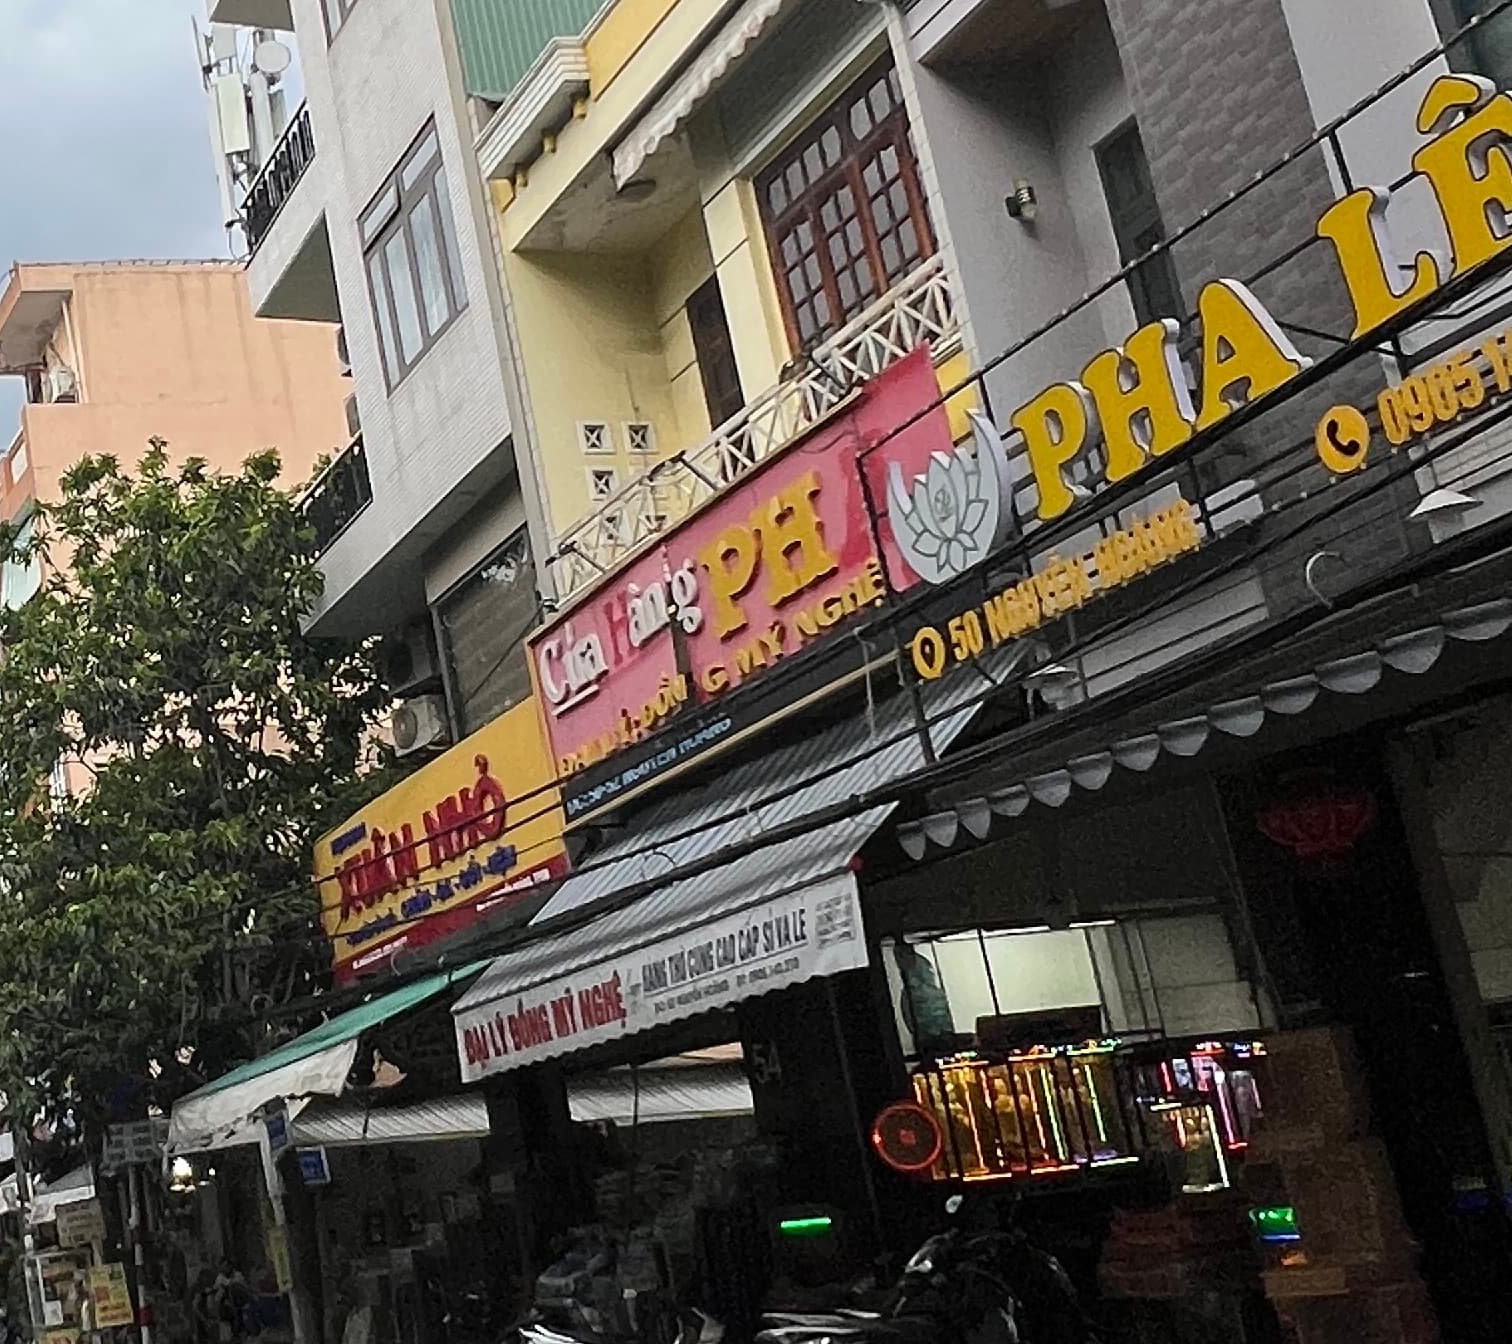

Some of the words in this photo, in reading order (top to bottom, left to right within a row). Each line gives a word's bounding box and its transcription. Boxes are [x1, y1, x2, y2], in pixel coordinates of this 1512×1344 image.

[1012, 279, 1310, 522] PHA
[1316, 72, 1512, 344] LÊ
[698, 469, 839, 642] PH
[948, 609, 984, 662] 50
